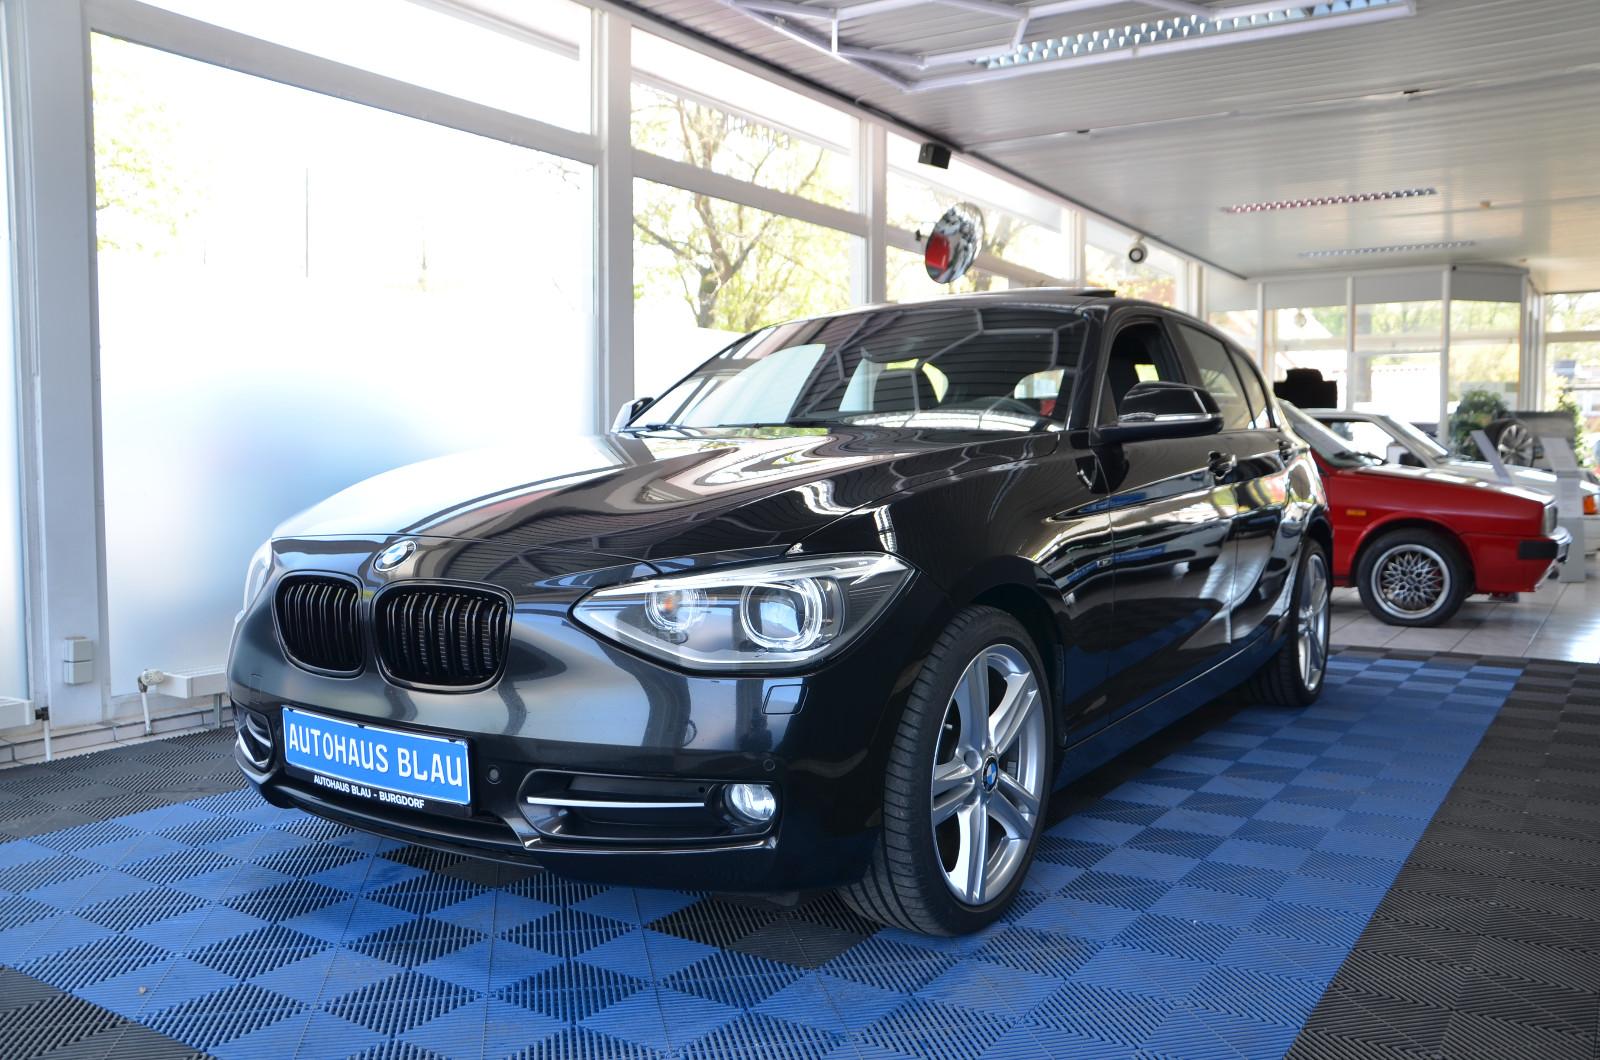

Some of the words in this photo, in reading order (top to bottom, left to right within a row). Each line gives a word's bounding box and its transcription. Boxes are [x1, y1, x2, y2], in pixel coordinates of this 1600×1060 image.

[289, 723, 389, 773] AUTOHAUS
[397, 747, 463, 787] BLAU
[314, 775, 350, 793] AUTOHAUS
[351, 785, 371, 799] BLAU
[379, 791, 425, 809] BURGDORF
